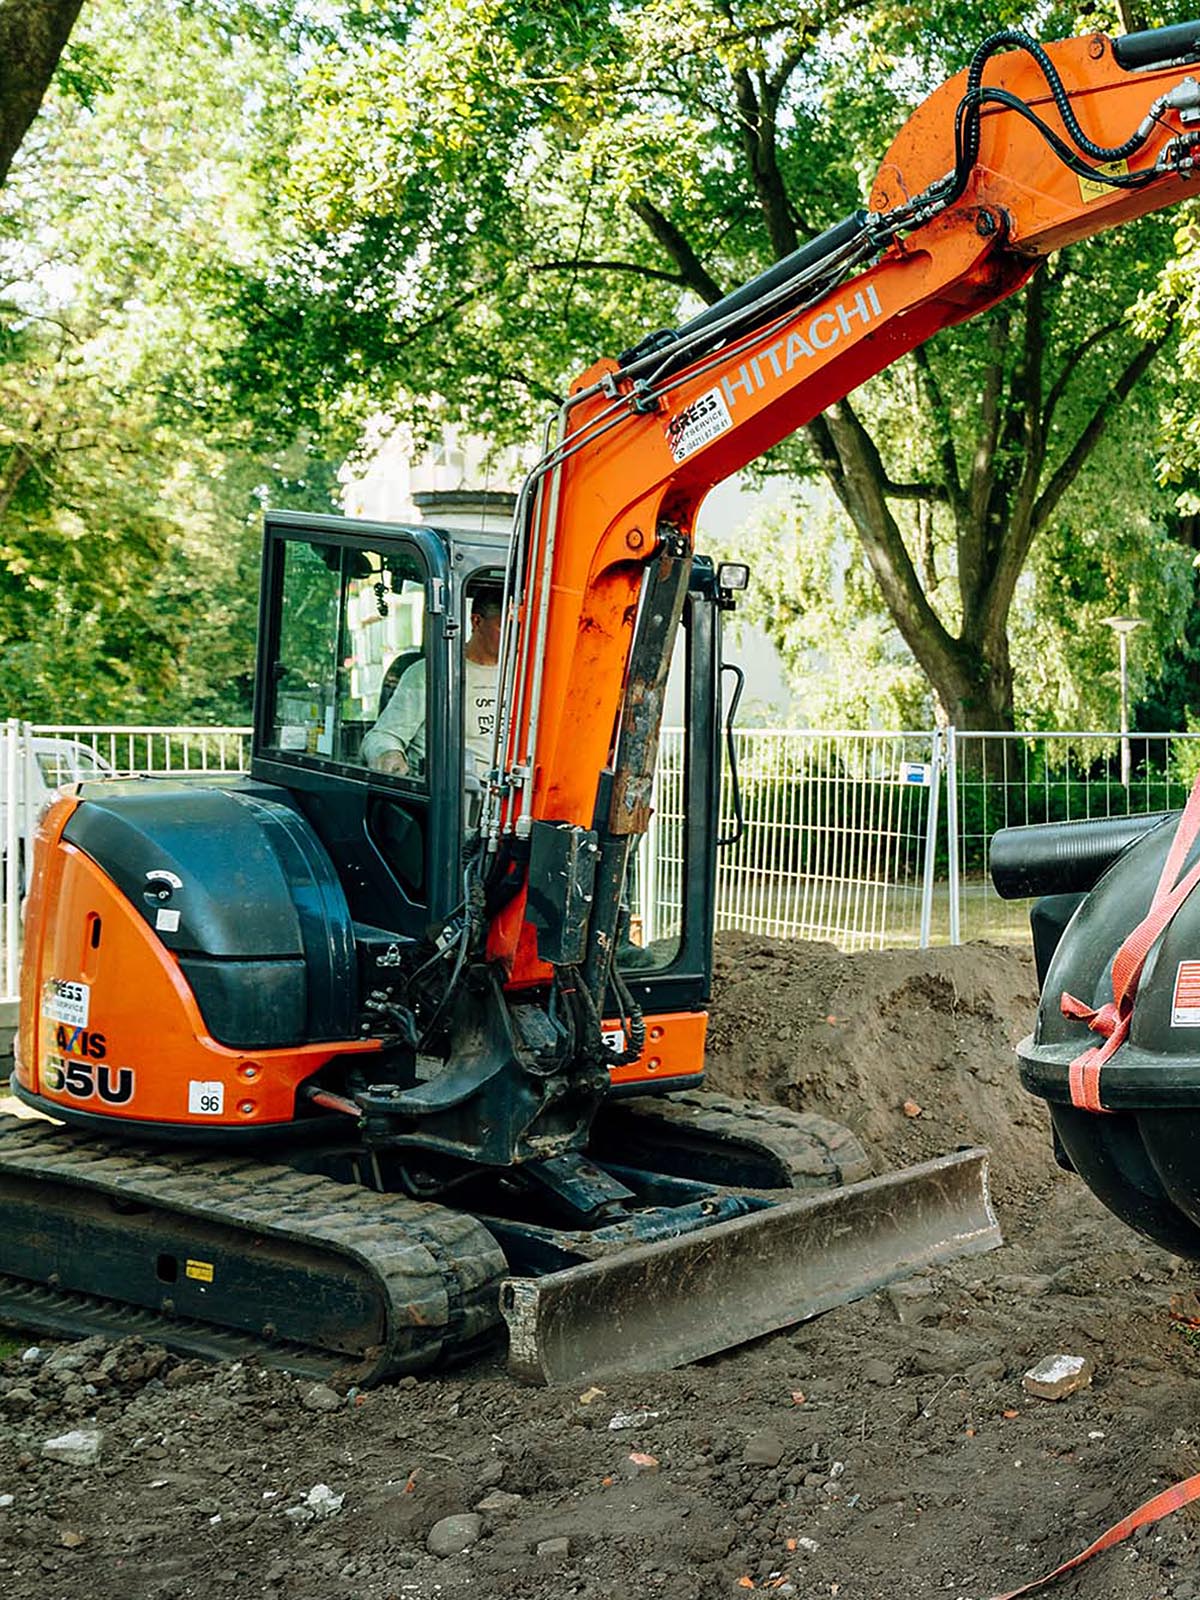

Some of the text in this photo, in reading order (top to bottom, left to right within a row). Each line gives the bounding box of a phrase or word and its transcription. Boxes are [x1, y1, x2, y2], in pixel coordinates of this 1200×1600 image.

[721, 284, 883, 407] HITACHI
[668, 394, 717, 436] GRESS
[50, 1023, 107, 1060] AXIS
[46, 1055, 134, 1104] 55U
[200, 1095, 220, 1113] 96
